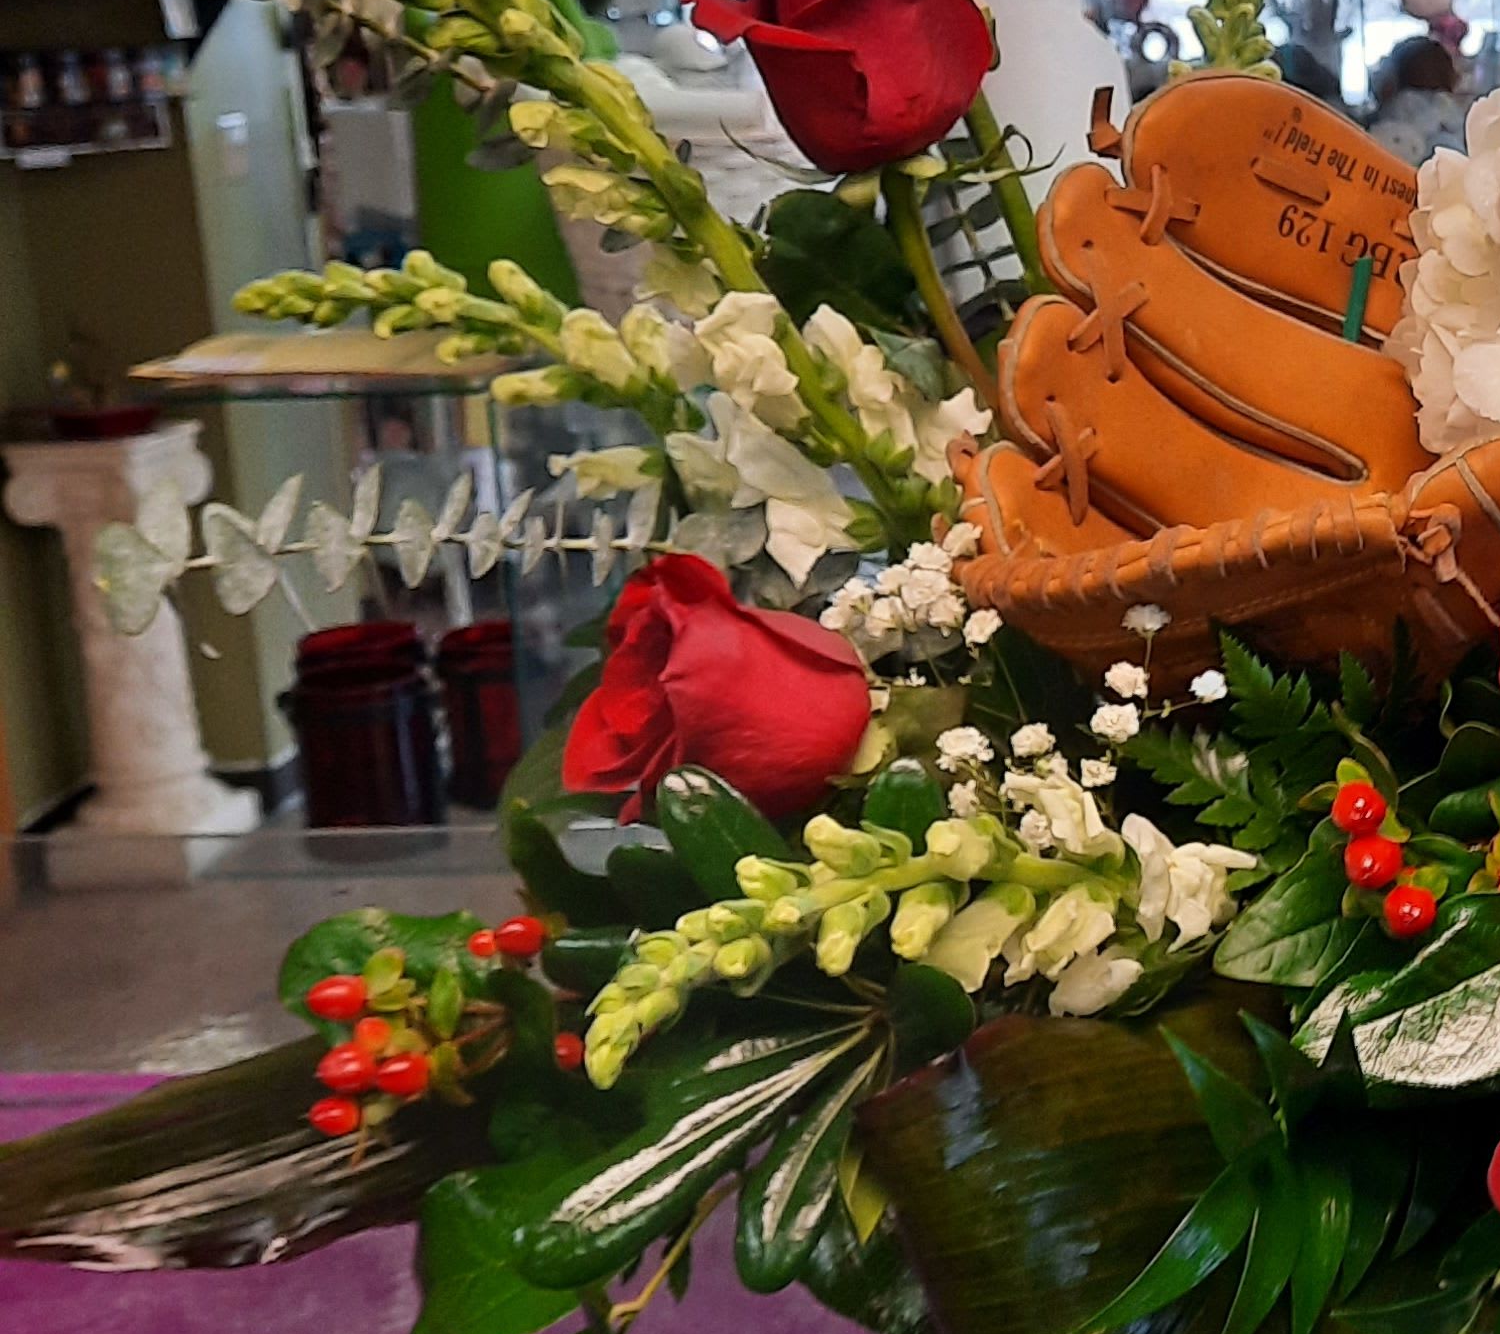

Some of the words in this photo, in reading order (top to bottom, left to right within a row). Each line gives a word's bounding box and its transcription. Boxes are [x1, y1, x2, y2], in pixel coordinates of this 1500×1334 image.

[1327, 147, 1357, 182] The
[1363, 164, 1379, 191] In
[1381, 175, 1416, 205] nest
[1278, 204, 1336, 253] 129
